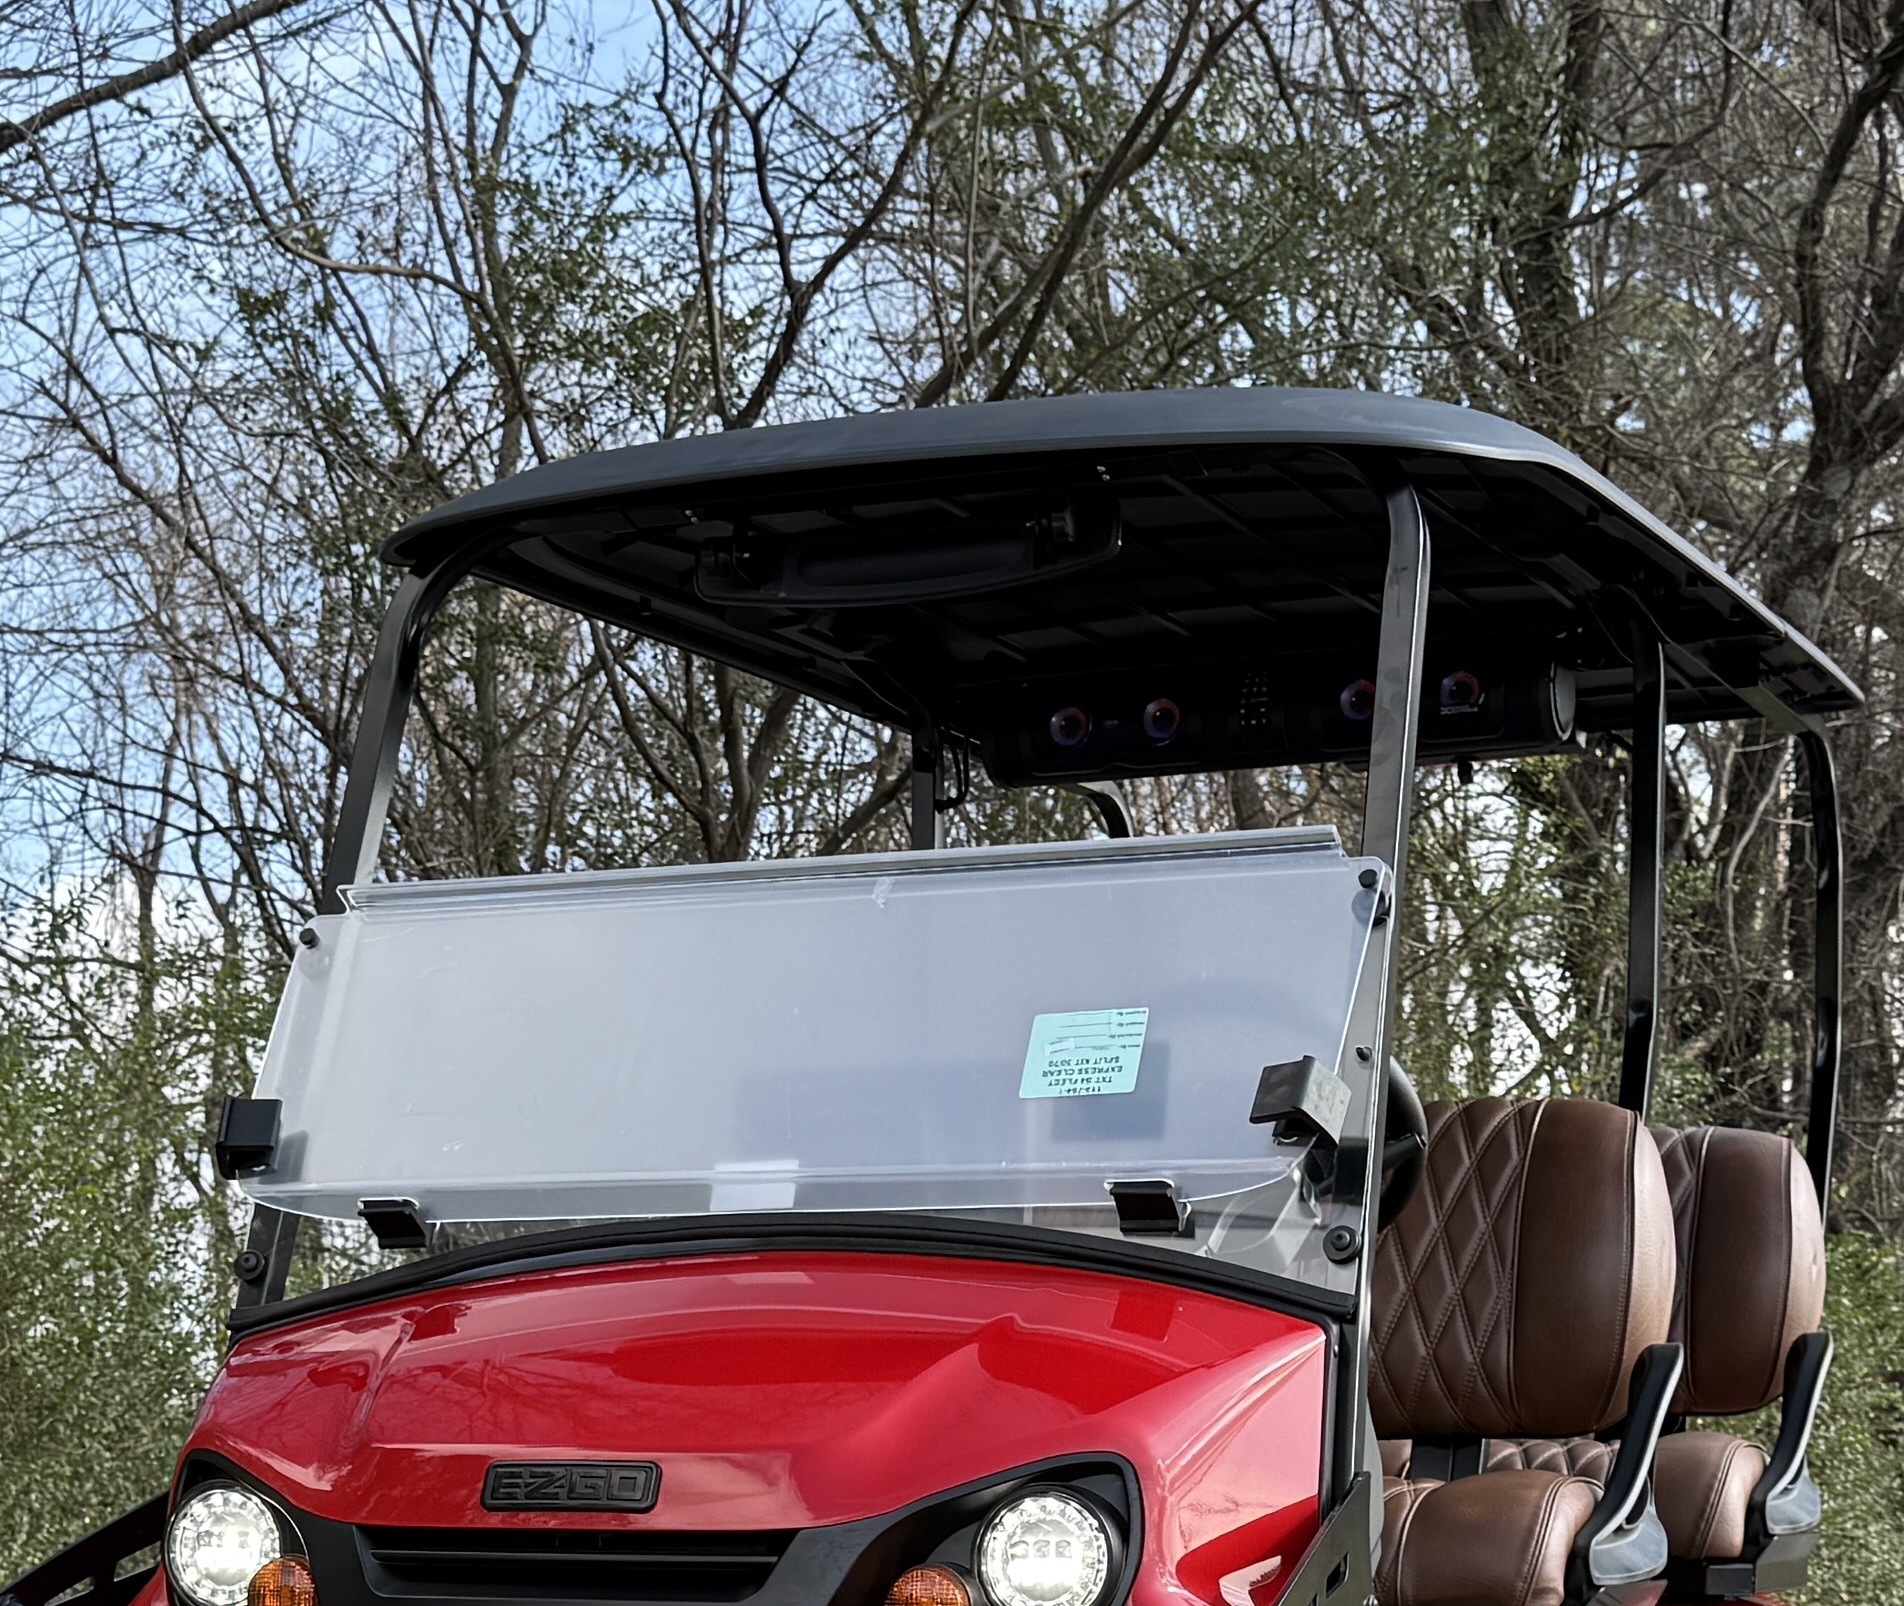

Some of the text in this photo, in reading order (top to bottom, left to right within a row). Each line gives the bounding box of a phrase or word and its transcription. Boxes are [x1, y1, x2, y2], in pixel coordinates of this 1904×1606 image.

[1074, 1058, 1090, 1066] KIT
[1093, 1056, 1120, 1065] SPLIT
[1042, 1069, 1075, 1078] CLEAR
